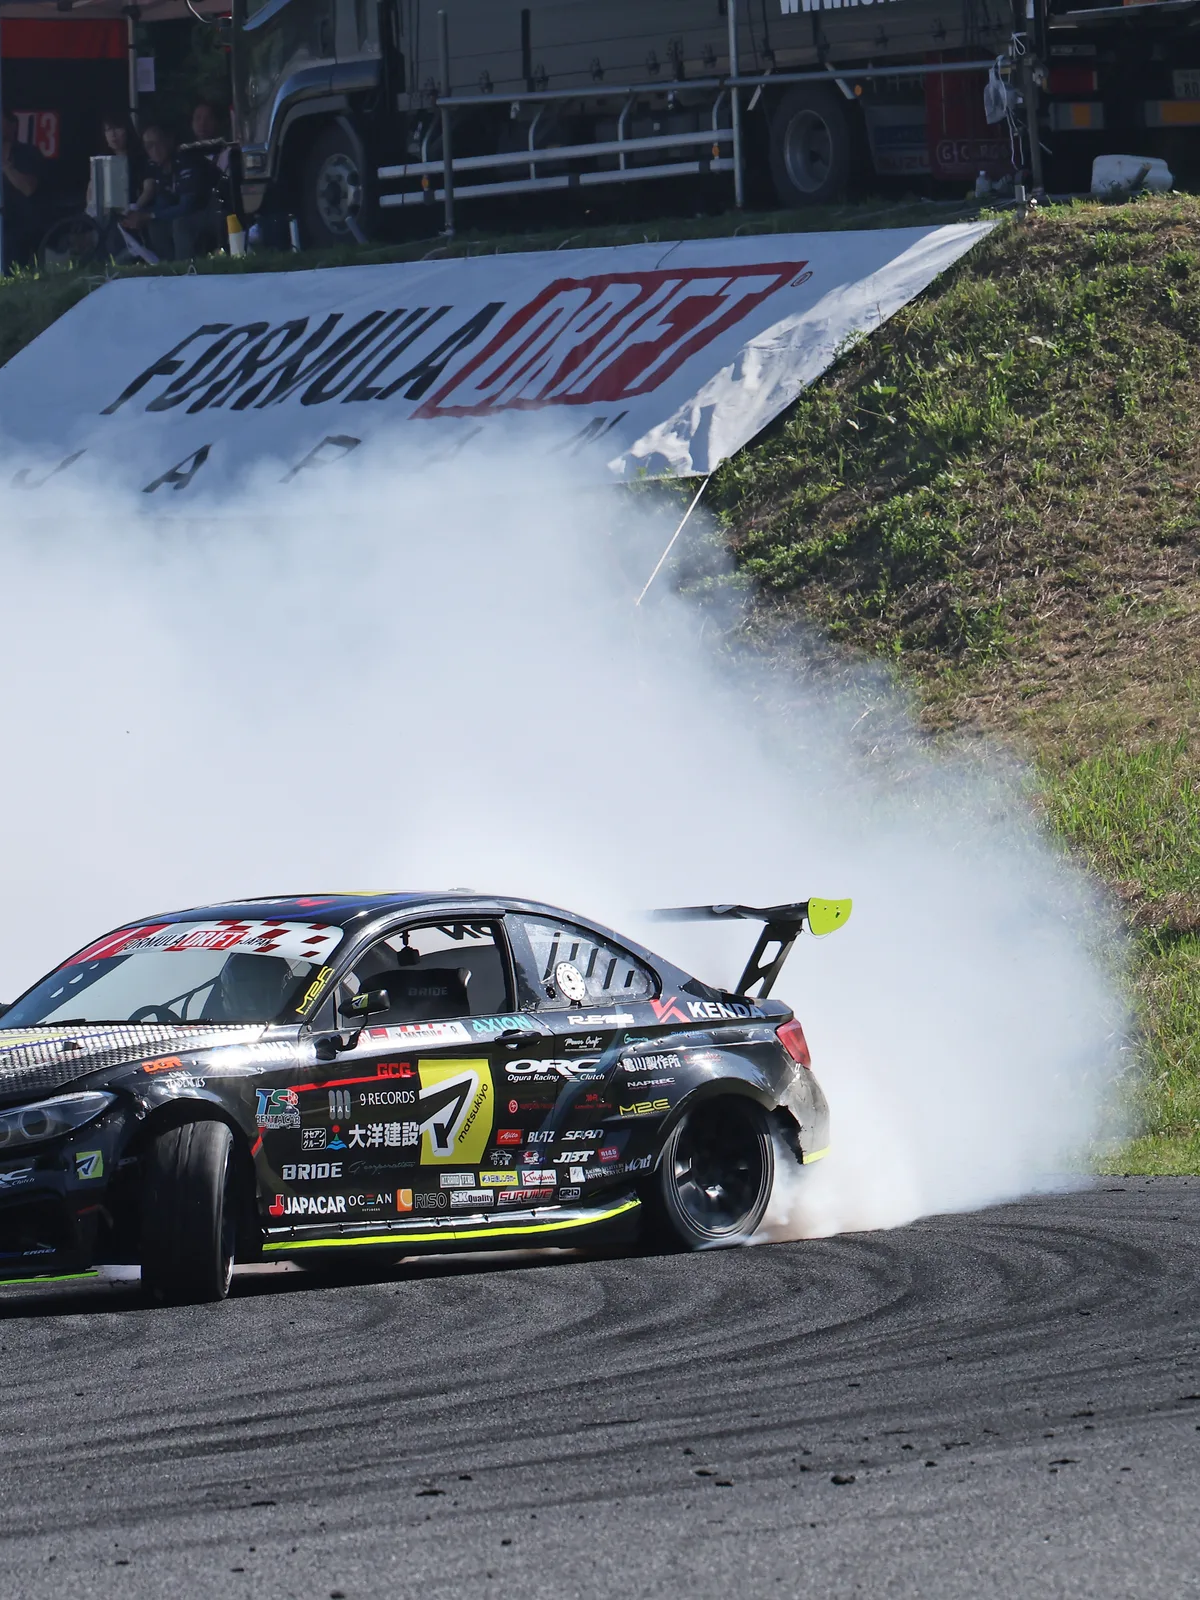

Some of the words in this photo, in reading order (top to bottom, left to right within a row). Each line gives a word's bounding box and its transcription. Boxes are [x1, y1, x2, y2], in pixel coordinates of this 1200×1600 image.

[100, 301, 507, 415] FORMULA
[436, 273, 784, 410] DRIFT
[121, 933, 189, 950] FORMULA
[184, 931, 247, 948] DRIFT
[686, 1001, 767, 1020] KENDA
[472, 1015, 534, 1034] AXION
[377, 1063, 413, 1078] GCG
[504, 1059, 602, 1076] ORC
[507, 1074, 532, 1083] Ogura
[533, 1073, 560, 1083] Racing
[580, 1073, 605, 1081] Clutch
[627, 1077, 676, 1088] NAPREC
[256, 1088, 290, 1115] TS
[360, 1093, 366, 1106] 9
[368, 1091, 416, 1106] RECORDS
[457, 1083, 489, 1144] matsukiyo
[302, 1129, 326, 1139] オセアン
[348, 1121, 421, 1149] 大洋建設
[528, 1131, 556, 1143] BLITZ
[302, 1139, 326, 1149] グループ
[282, 1162, 343, 1181] BRIDE
[348, 1193, 392, 1207] OCEAN
[414, 1192, 448, 1209] RISO
[451, 1191, 468, 1203] SK
[468, 1194, 494, 1203] Quality
[559, 1188, 580, 1197] GRID
[284, 1195, 347, 1215] JAPACAR
